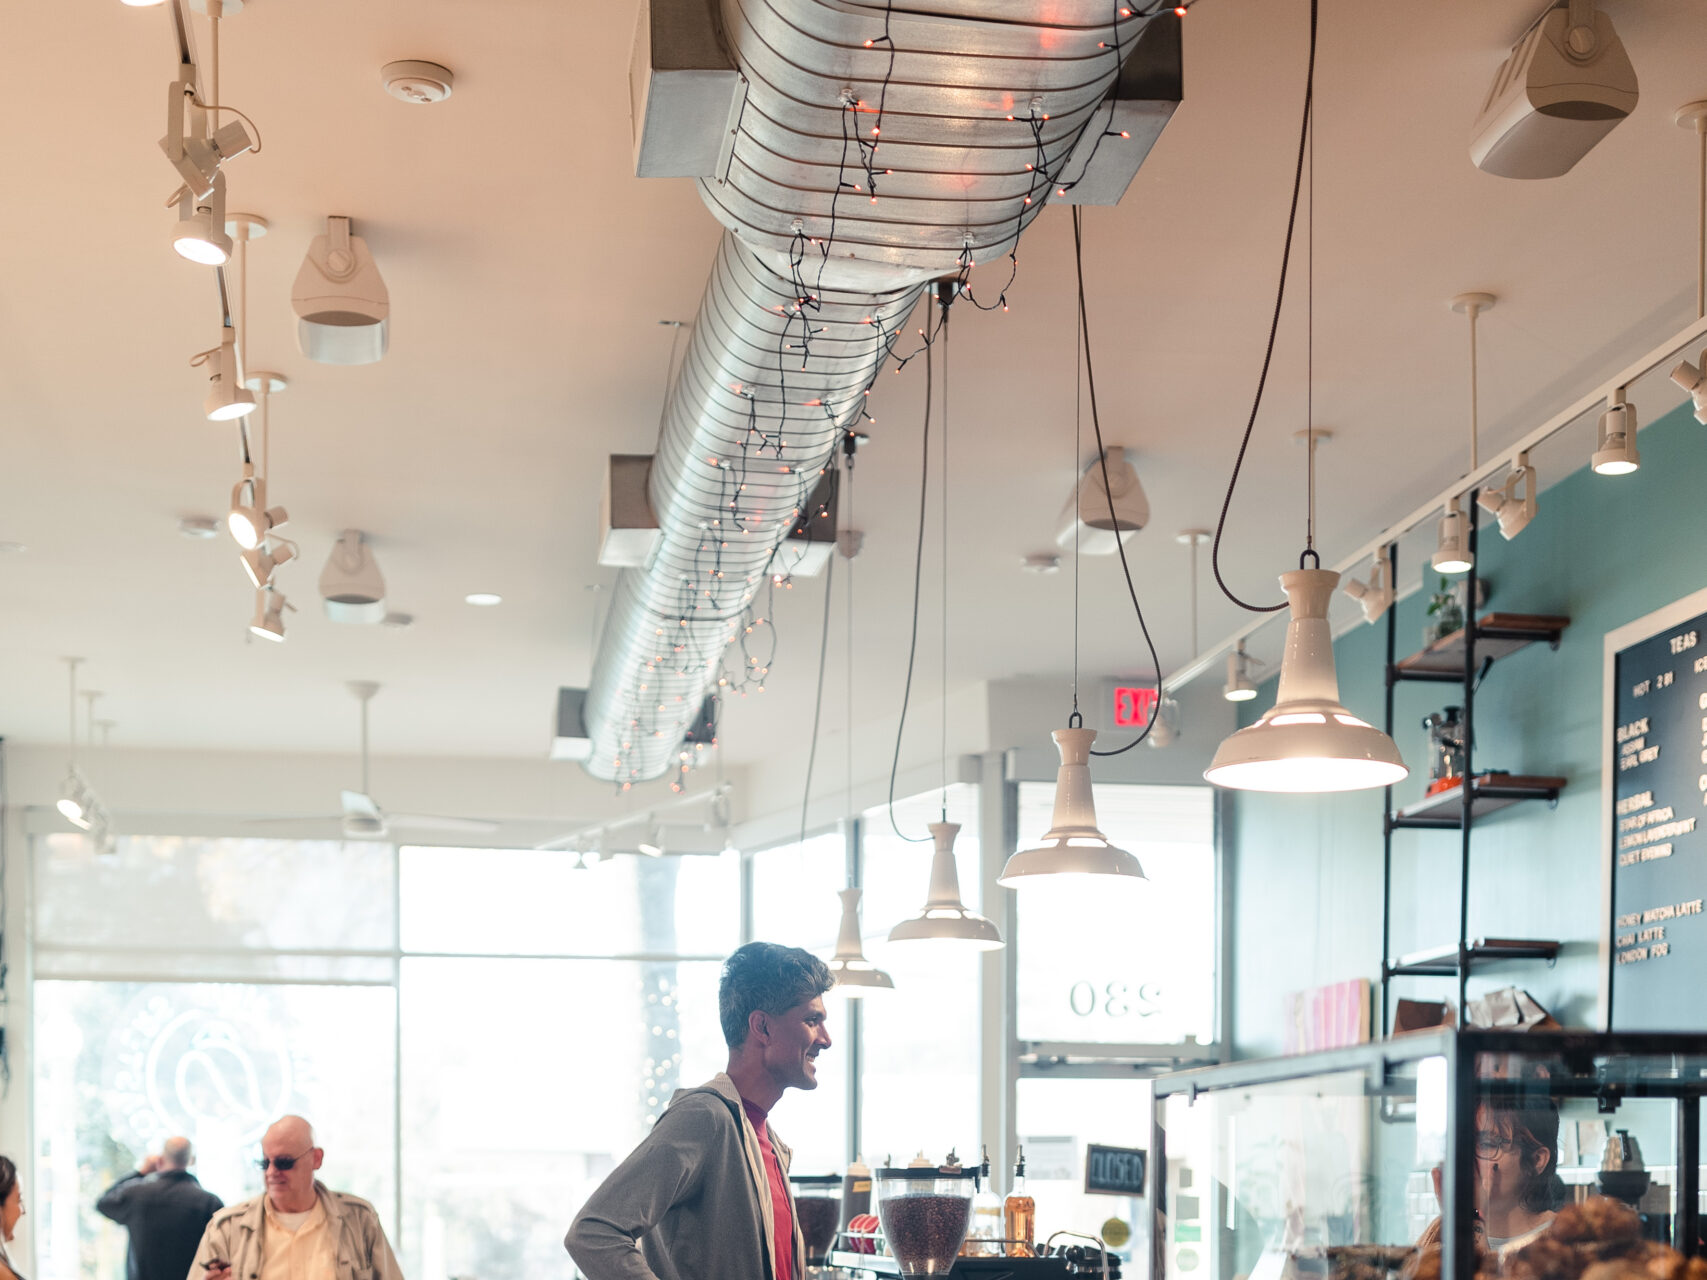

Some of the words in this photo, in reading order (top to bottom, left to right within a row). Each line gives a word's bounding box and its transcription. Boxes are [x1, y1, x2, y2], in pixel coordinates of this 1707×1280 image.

[1669, 631, 1697, 655] TEAS
[1617, 717, 1649, 743] BLACK
[1675, 899, 1702, 917] LATTE
[1638, 926, 1665, 943] LATTE
[1092, 1152, 1143, 1186] CLOSED
